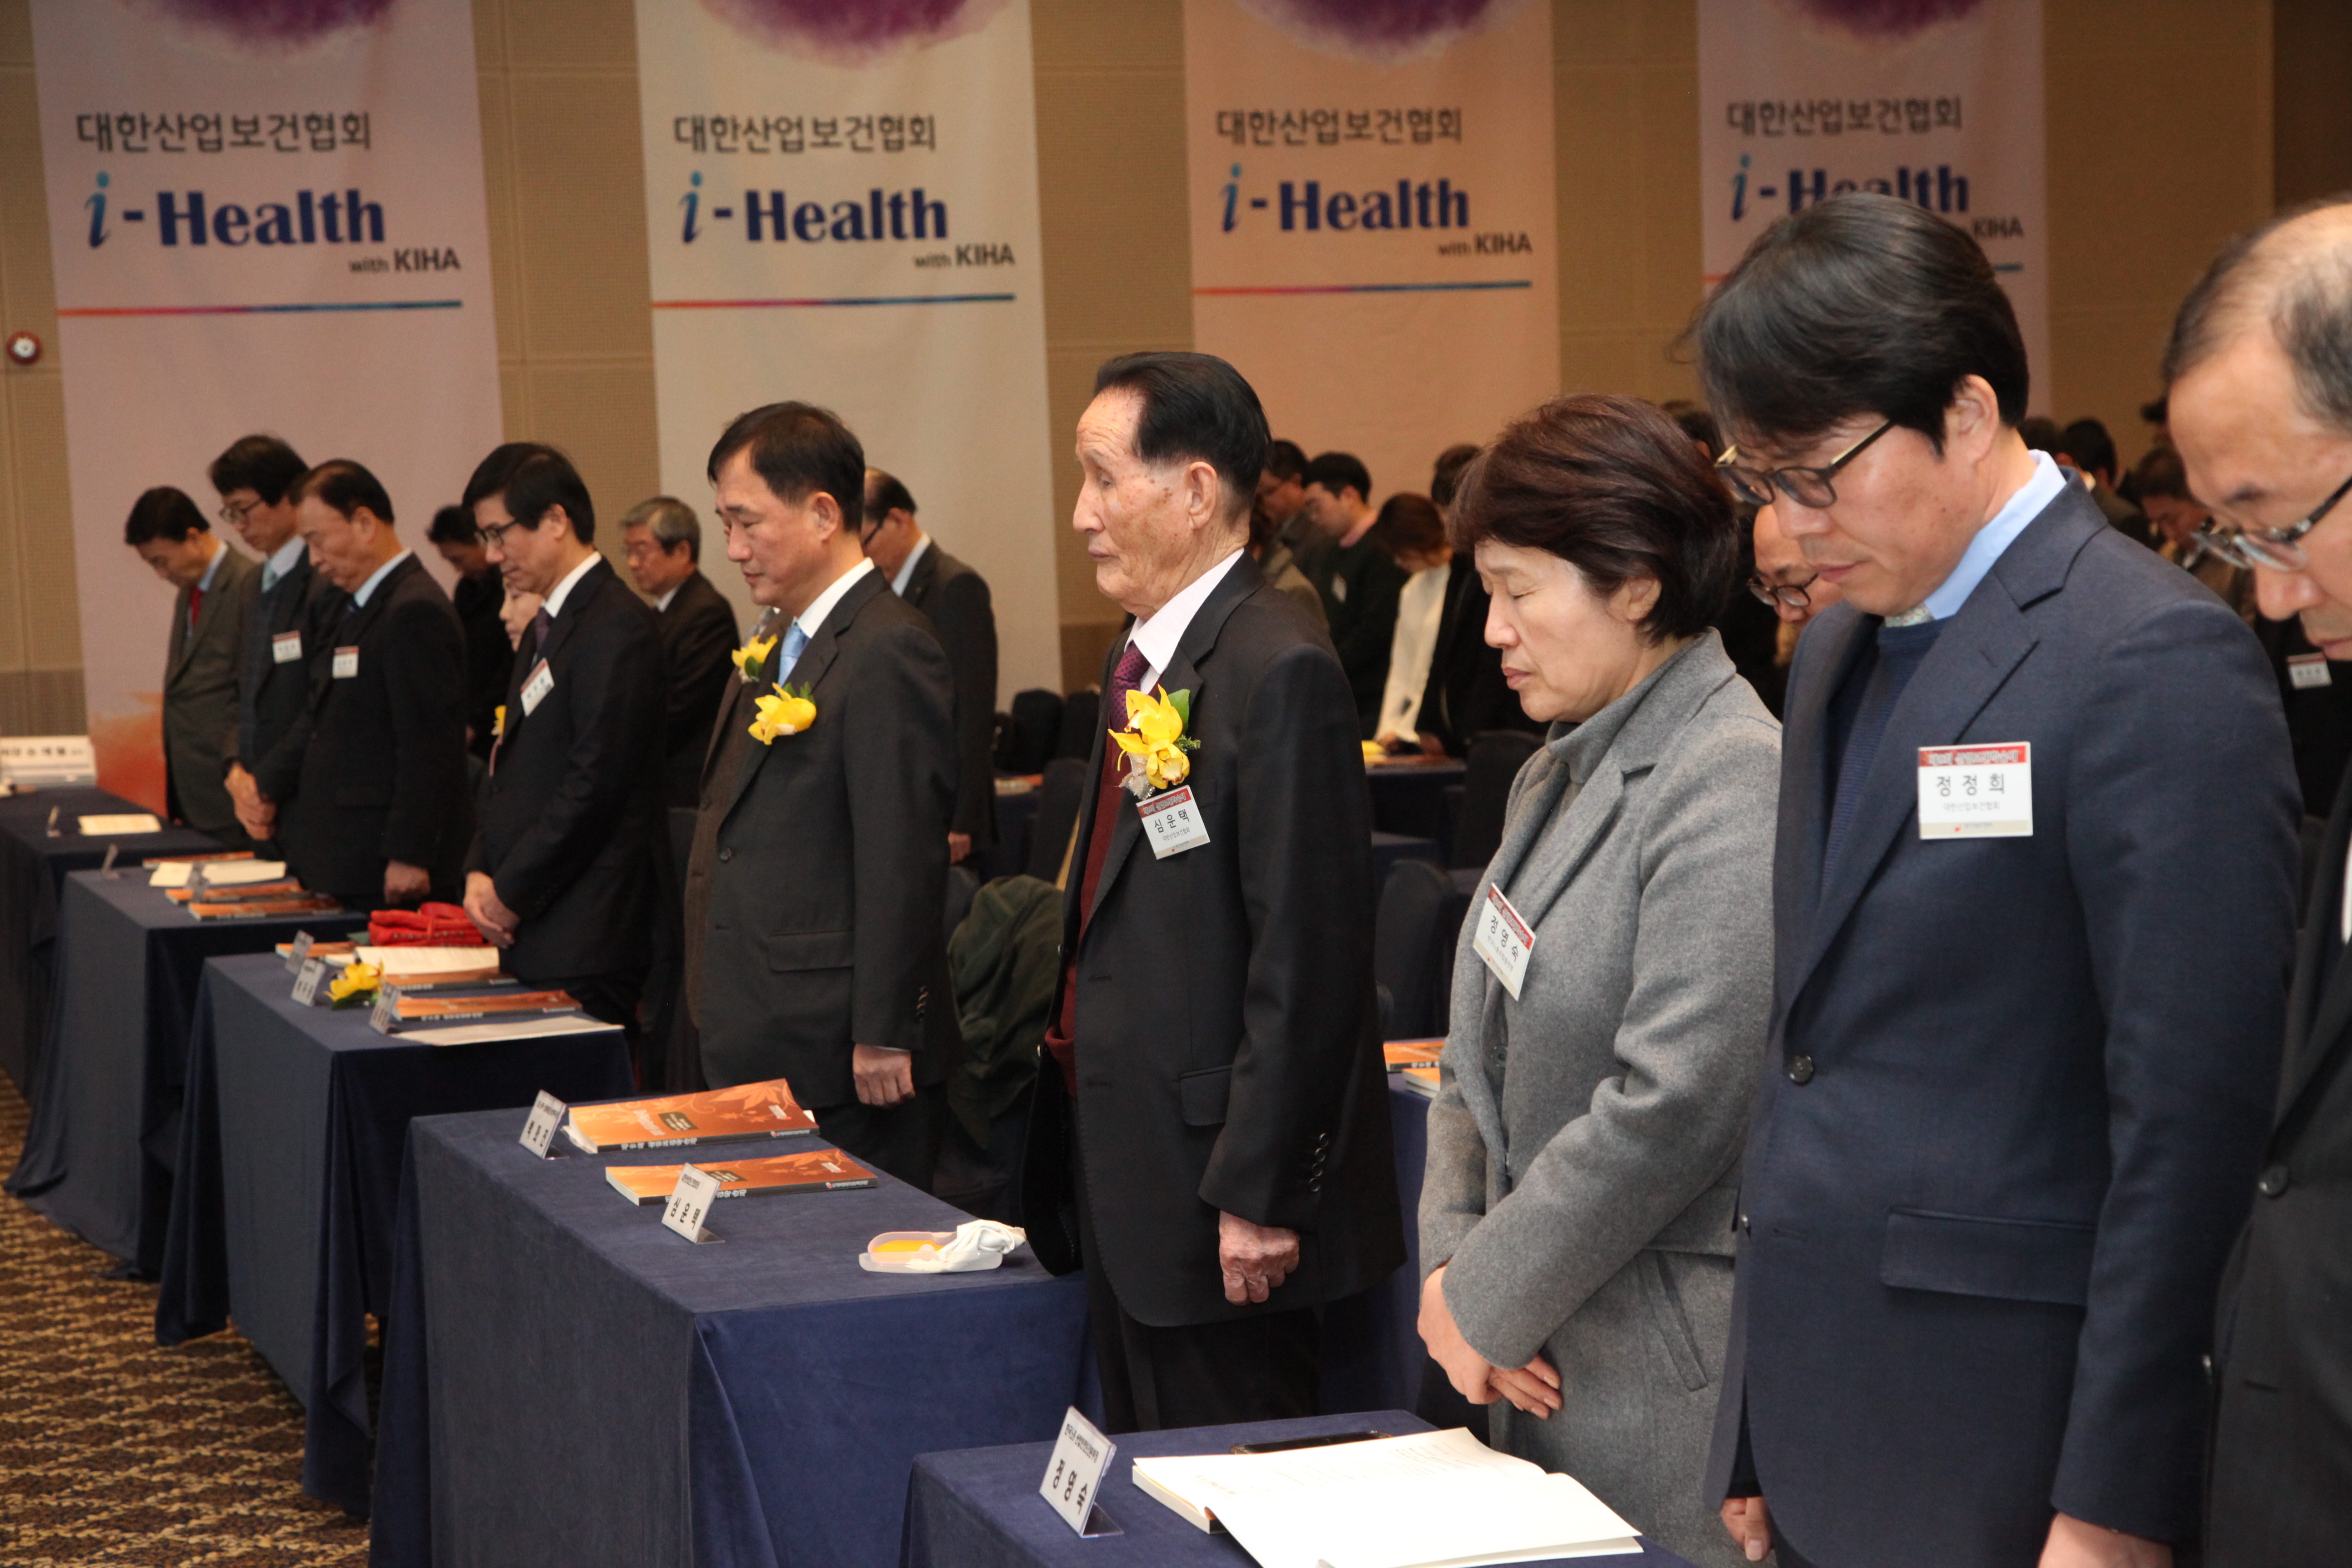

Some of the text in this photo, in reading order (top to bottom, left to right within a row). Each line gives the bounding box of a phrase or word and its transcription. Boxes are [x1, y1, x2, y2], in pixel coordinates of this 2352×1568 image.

[75, 111, 371, 153] 대한산업보건협회
[673, 114, 936, 154] 대한산업보건협회
[1215, 107, 1462, 147] 대한산업보건협회
[1727, 96, 1963, 137] 대한산업보건협회
[85, 170, 386, 249] i-Health
[681, 171, 948, 245] i-Health
[1222, 163, 1469, 232] i-Health
[349, 248, 461, 273] with KIHA
[913, 244, 1016, 268] with KIHA
[1438, 232, 1533, 256] with KIHA
